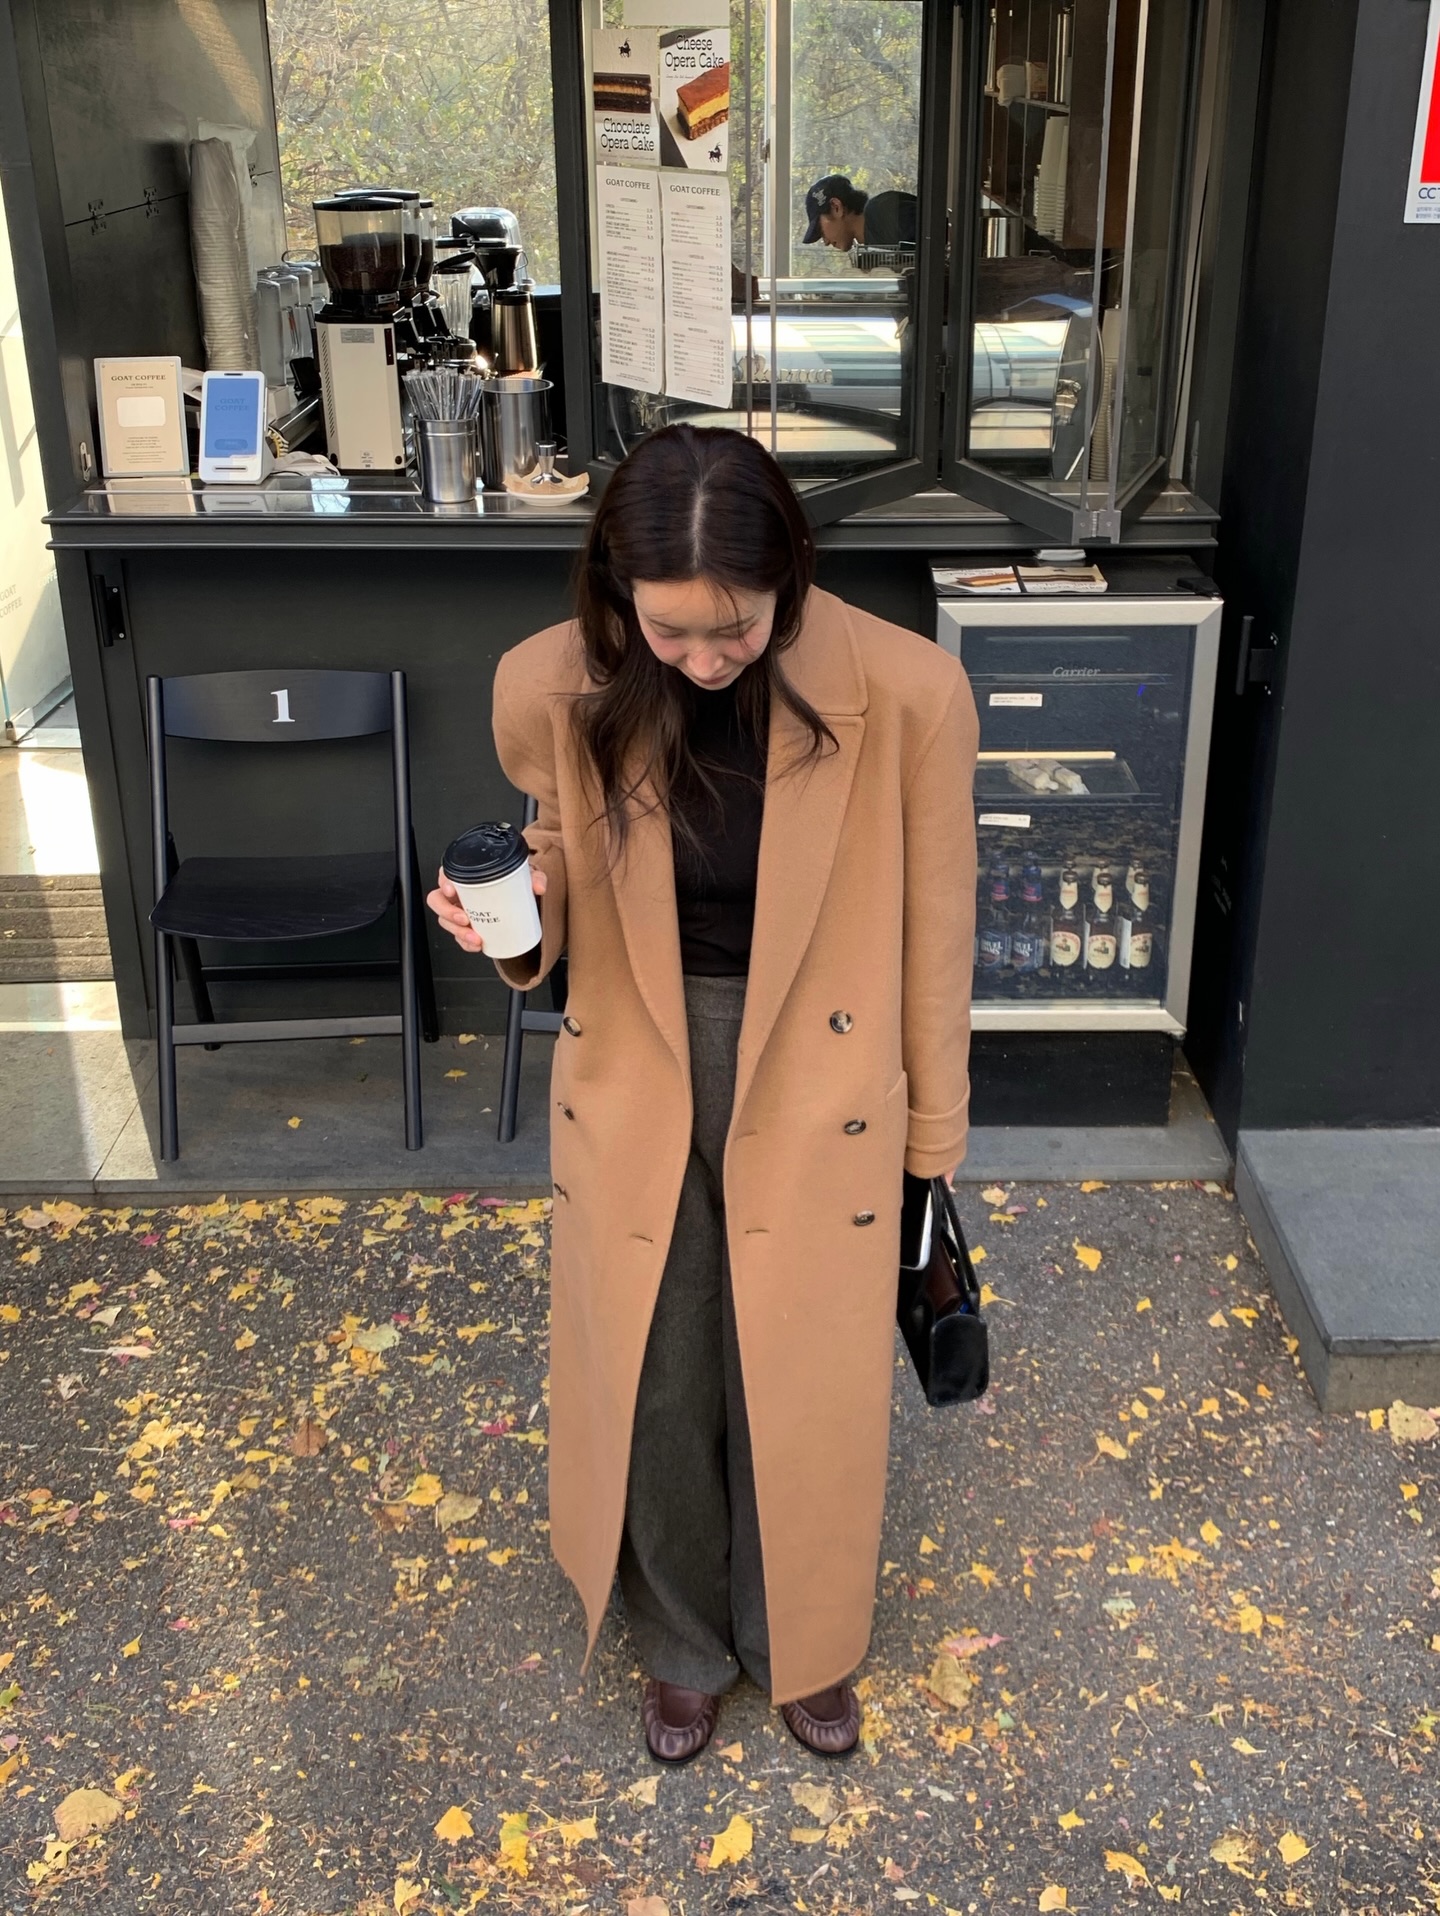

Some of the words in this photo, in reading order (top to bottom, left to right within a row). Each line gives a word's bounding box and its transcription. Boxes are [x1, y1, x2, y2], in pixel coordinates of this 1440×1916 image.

[676, 35, 712, 51] Cheese
[665, 52, 696, 71] Opera
[699, 53, 725, 68] Cake
[604, 118, 650, 134] Chocolate
[601, 134, 630, 152] Opera
[632, 136, 655, 151] Cake
[606, 178, 625, 187] GOAT
[625, 180, 651, 190] COFFEE
[670, 185, 691, 194] GOAT
[692, 186, 720, 196] COFFEE
[1418, 187, 1440, 199] CC
[0, 584, 17, 601] GOAT
[0, 596, 23, 618] COFFEE
[1052, 666, 1101, 678] Carrier
[270, 689, 296, 723] 1
[470, 915, 501, 924] OFFEE
